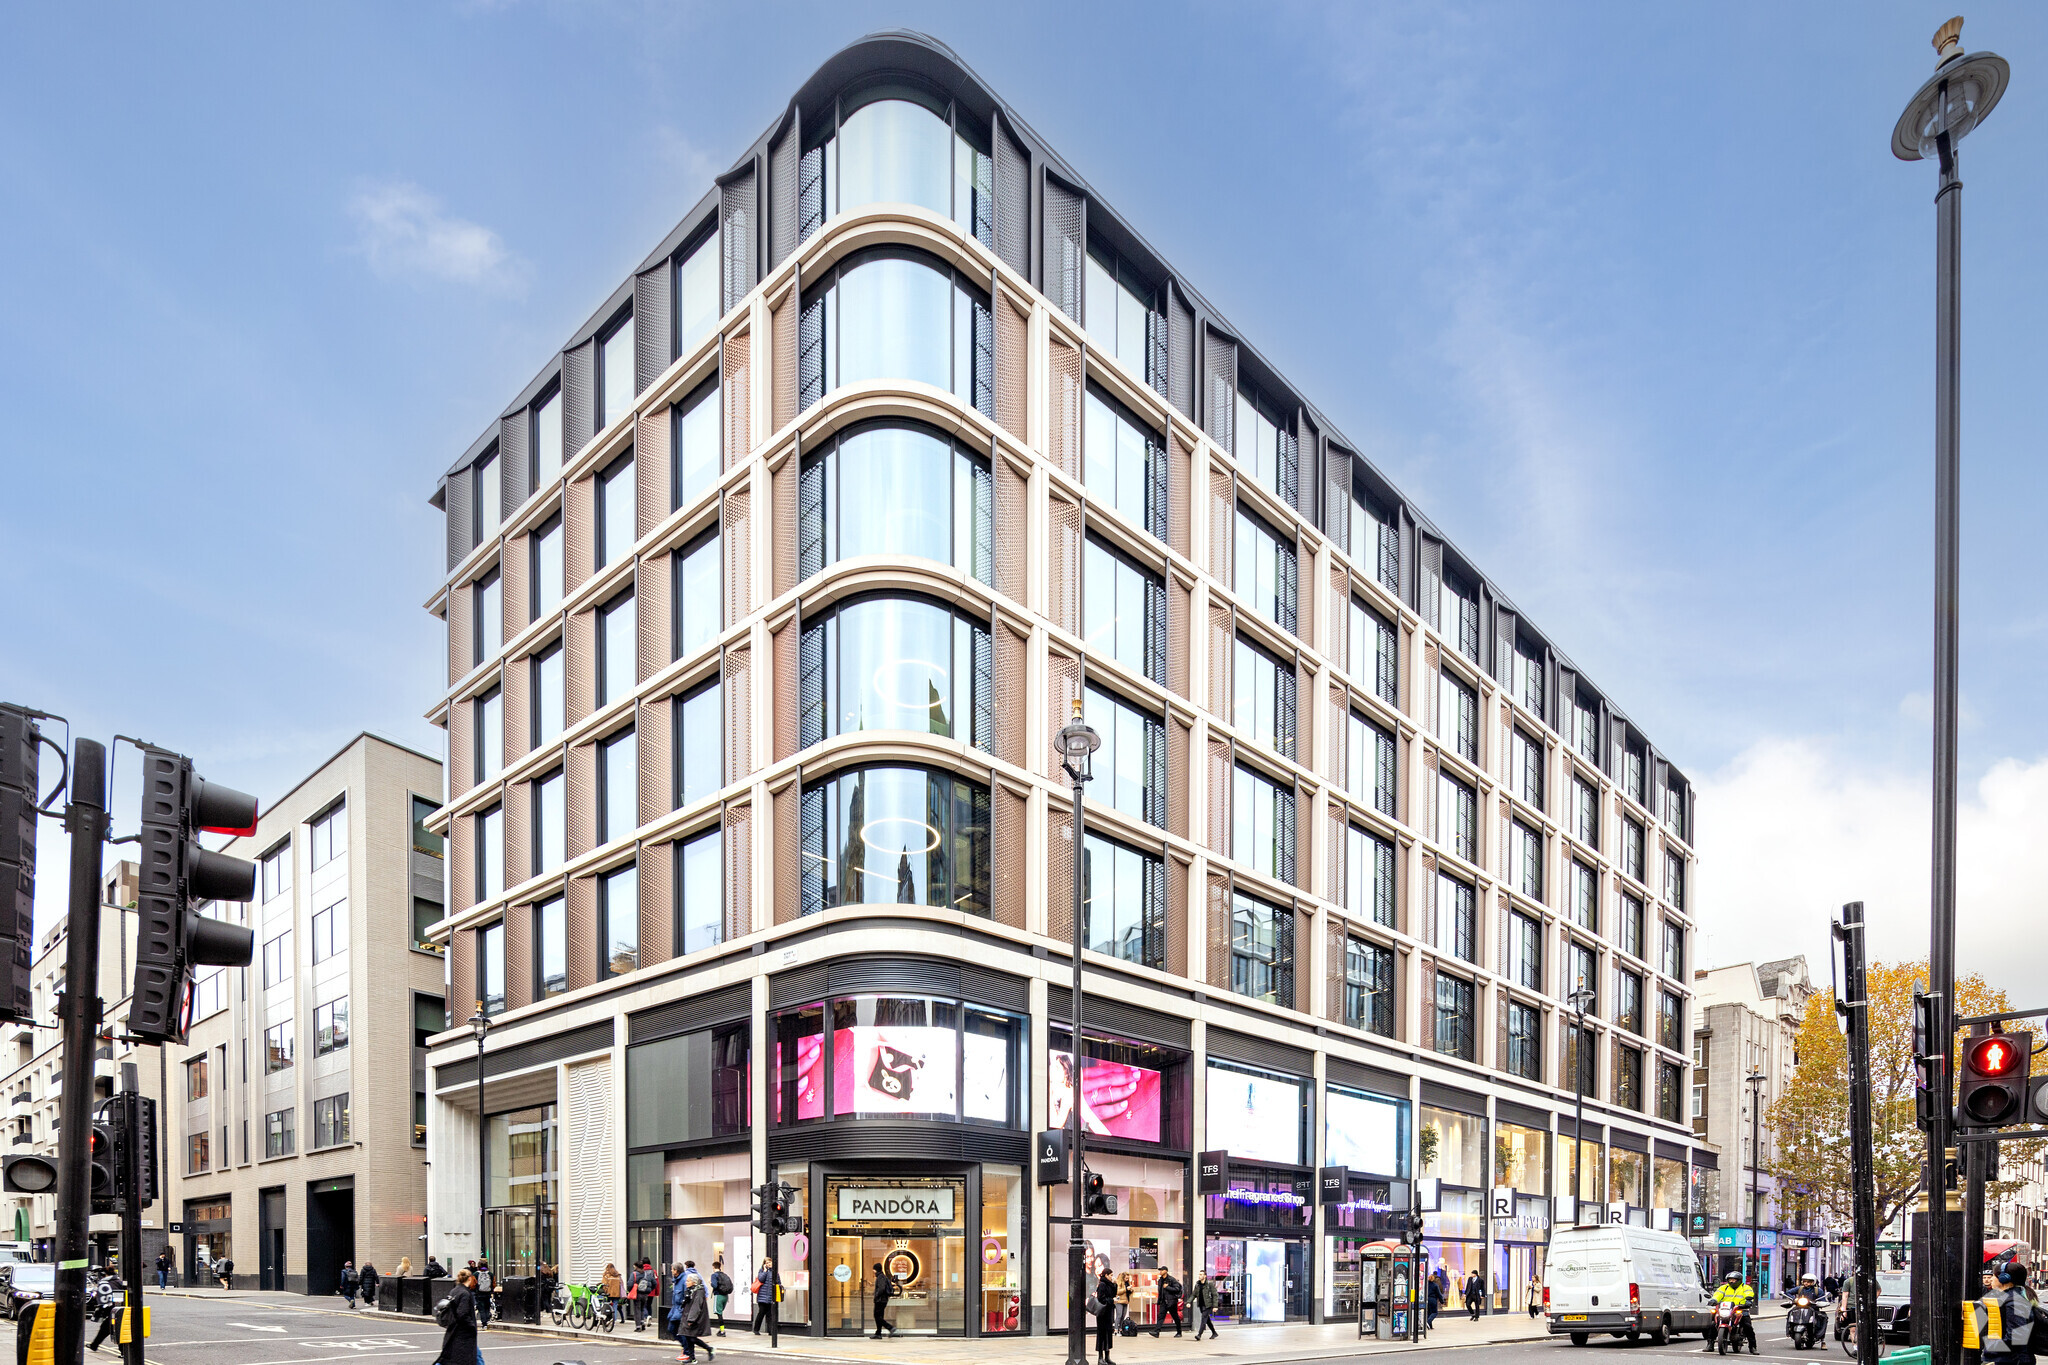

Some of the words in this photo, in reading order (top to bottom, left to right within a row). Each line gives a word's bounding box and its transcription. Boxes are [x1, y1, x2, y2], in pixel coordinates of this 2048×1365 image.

[1203, 1165, 1218, 1173] TFS
[1282, 1193, 1305, 1206] Shop
[1495, 1198, 1509, 1214] R
[852, 1199, 940, 1214] PANDORA
[1611, 1211, 1623, 1224] R
[1719, 1237, 1733, 1245] AB
